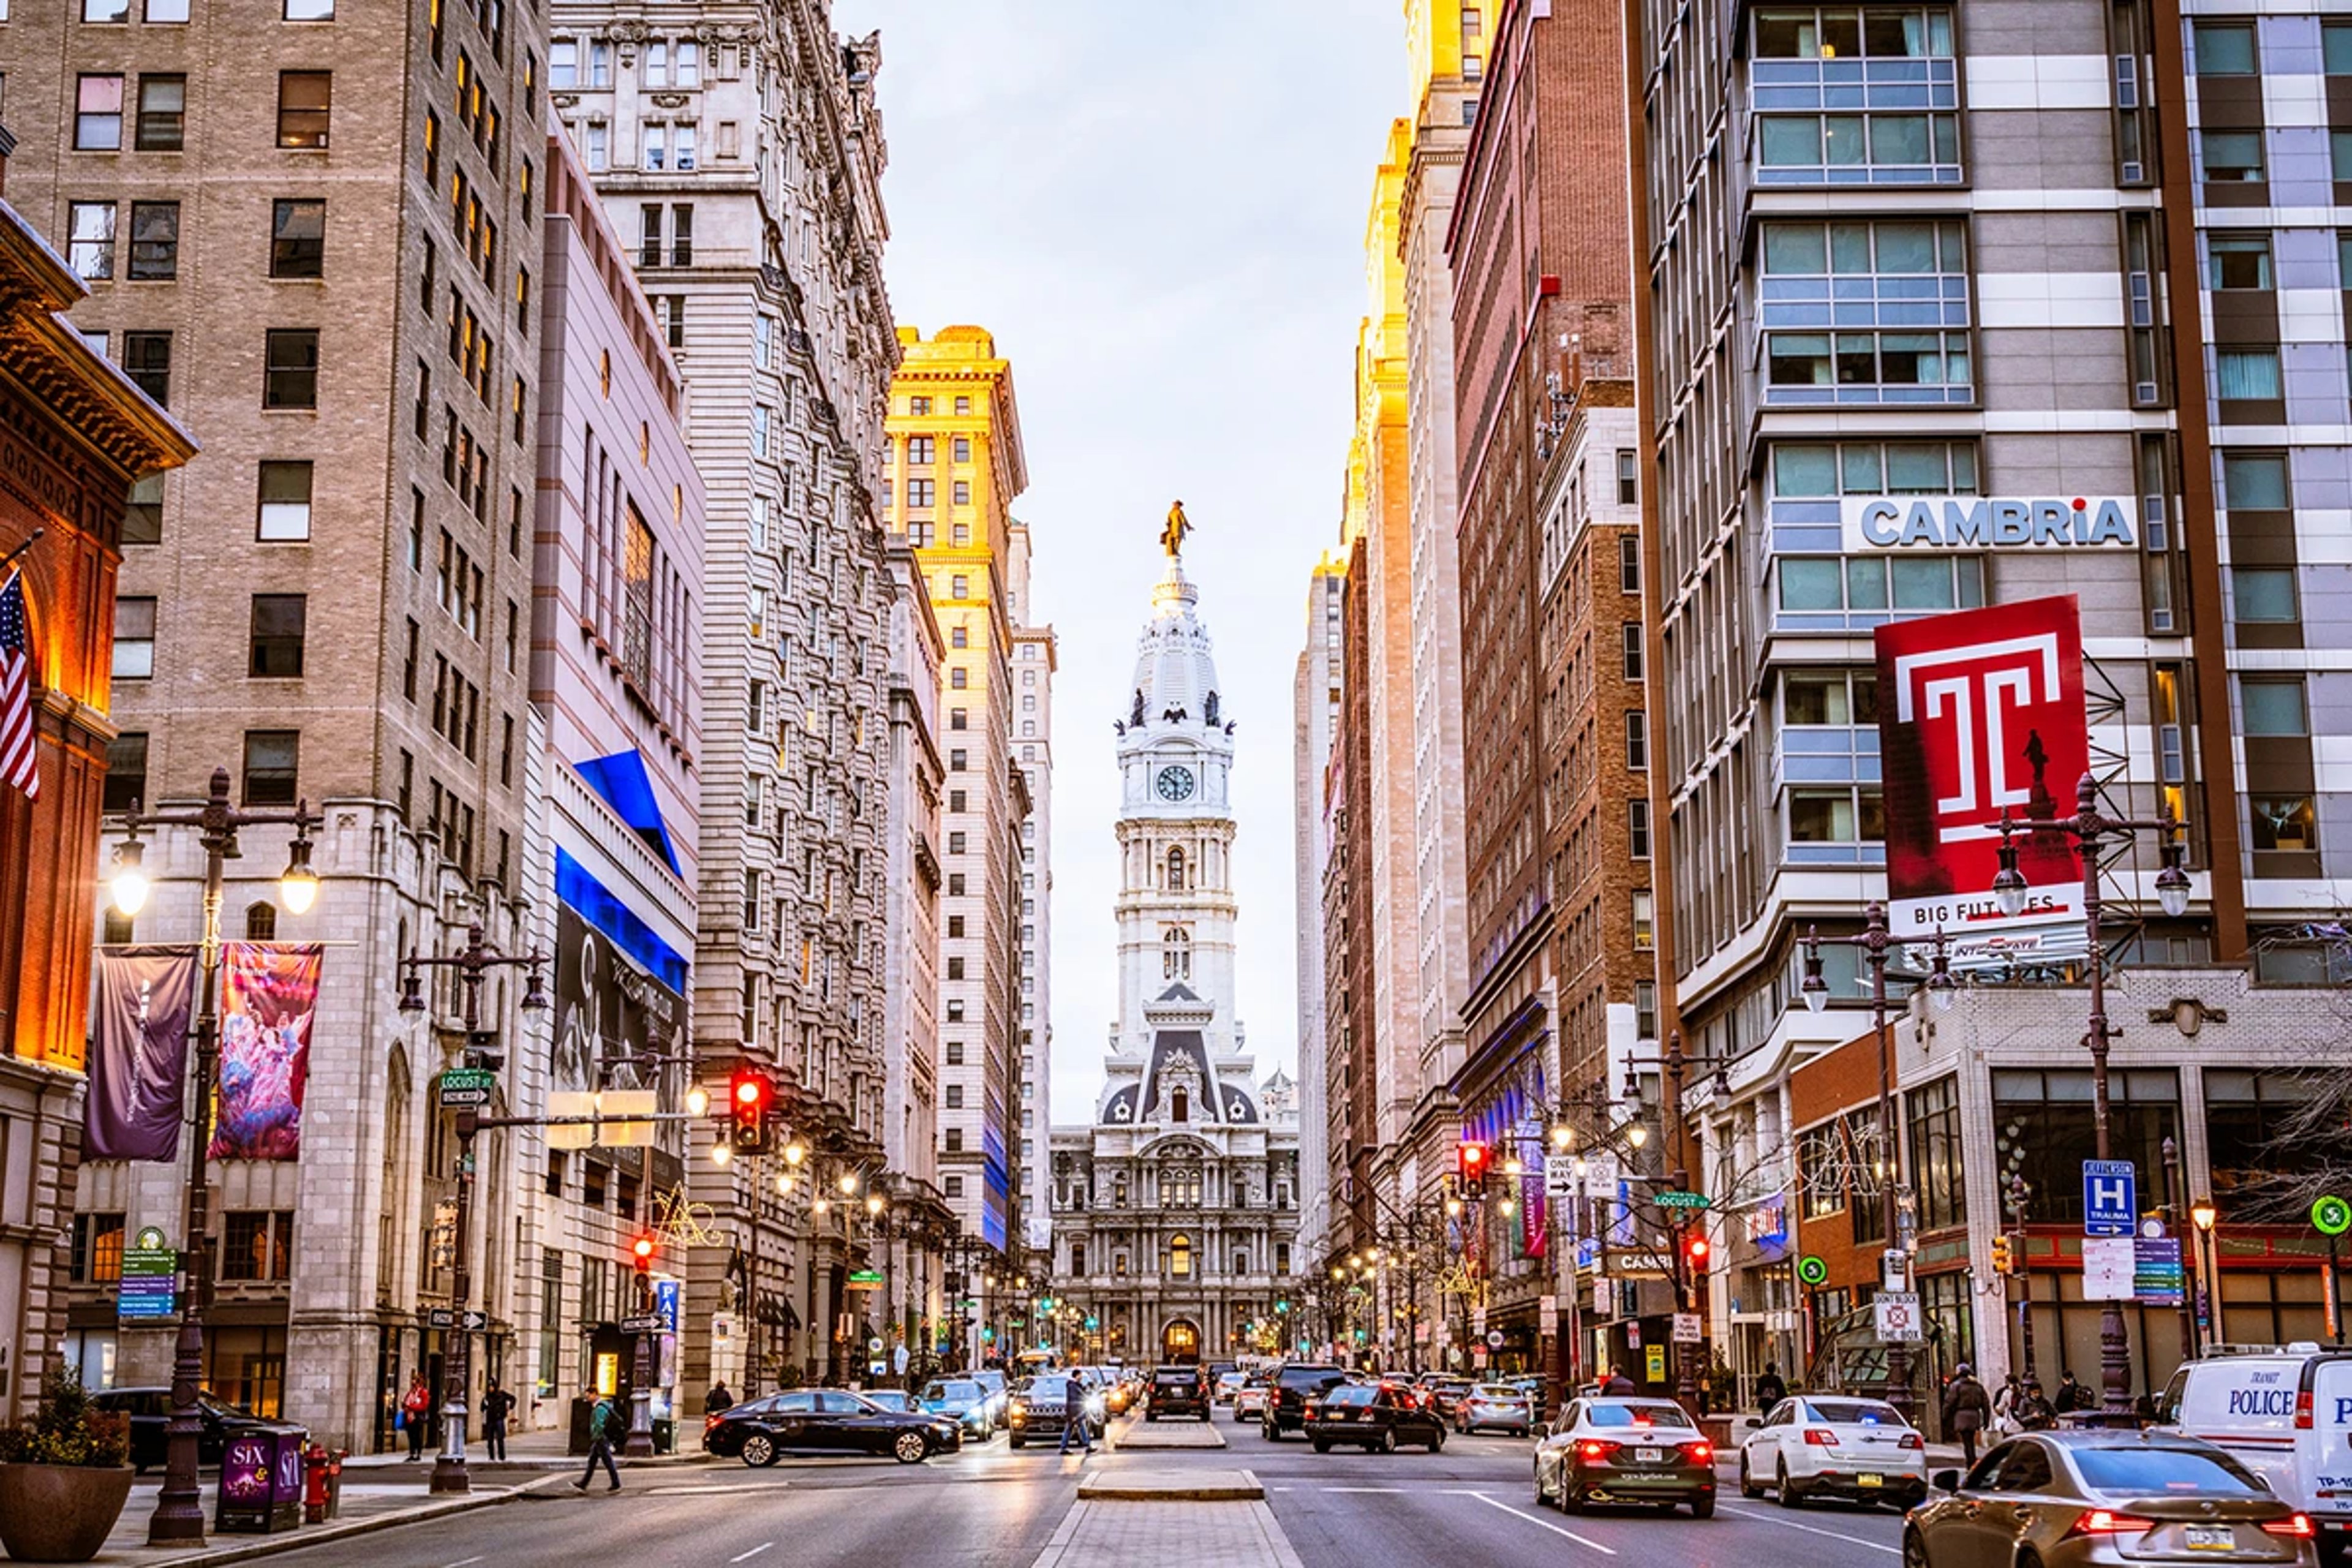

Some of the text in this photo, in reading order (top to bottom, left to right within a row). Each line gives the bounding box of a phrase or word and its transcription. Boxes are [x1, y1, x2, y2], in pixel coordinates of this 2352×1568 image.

[1915, 895, 2054, 924] BIG FUTES
[442, 1076, 479, 1088] LOCUST
[1550, 1159, 1570, 1169] ONE
[2094, 1179, 2125, 1210] H
[1655, 1196, 1695, 1207] LOCUST
[2090, 1211, 2130, 1220] TRAUMA
[1895, 1295, 1917, 1304] BLOCK
[662, 1286, 673, 1332] PAR
[1880, 1329, 1920, 1340] THE BOX
[2228, 1390, 2294, 1415] POLICE
